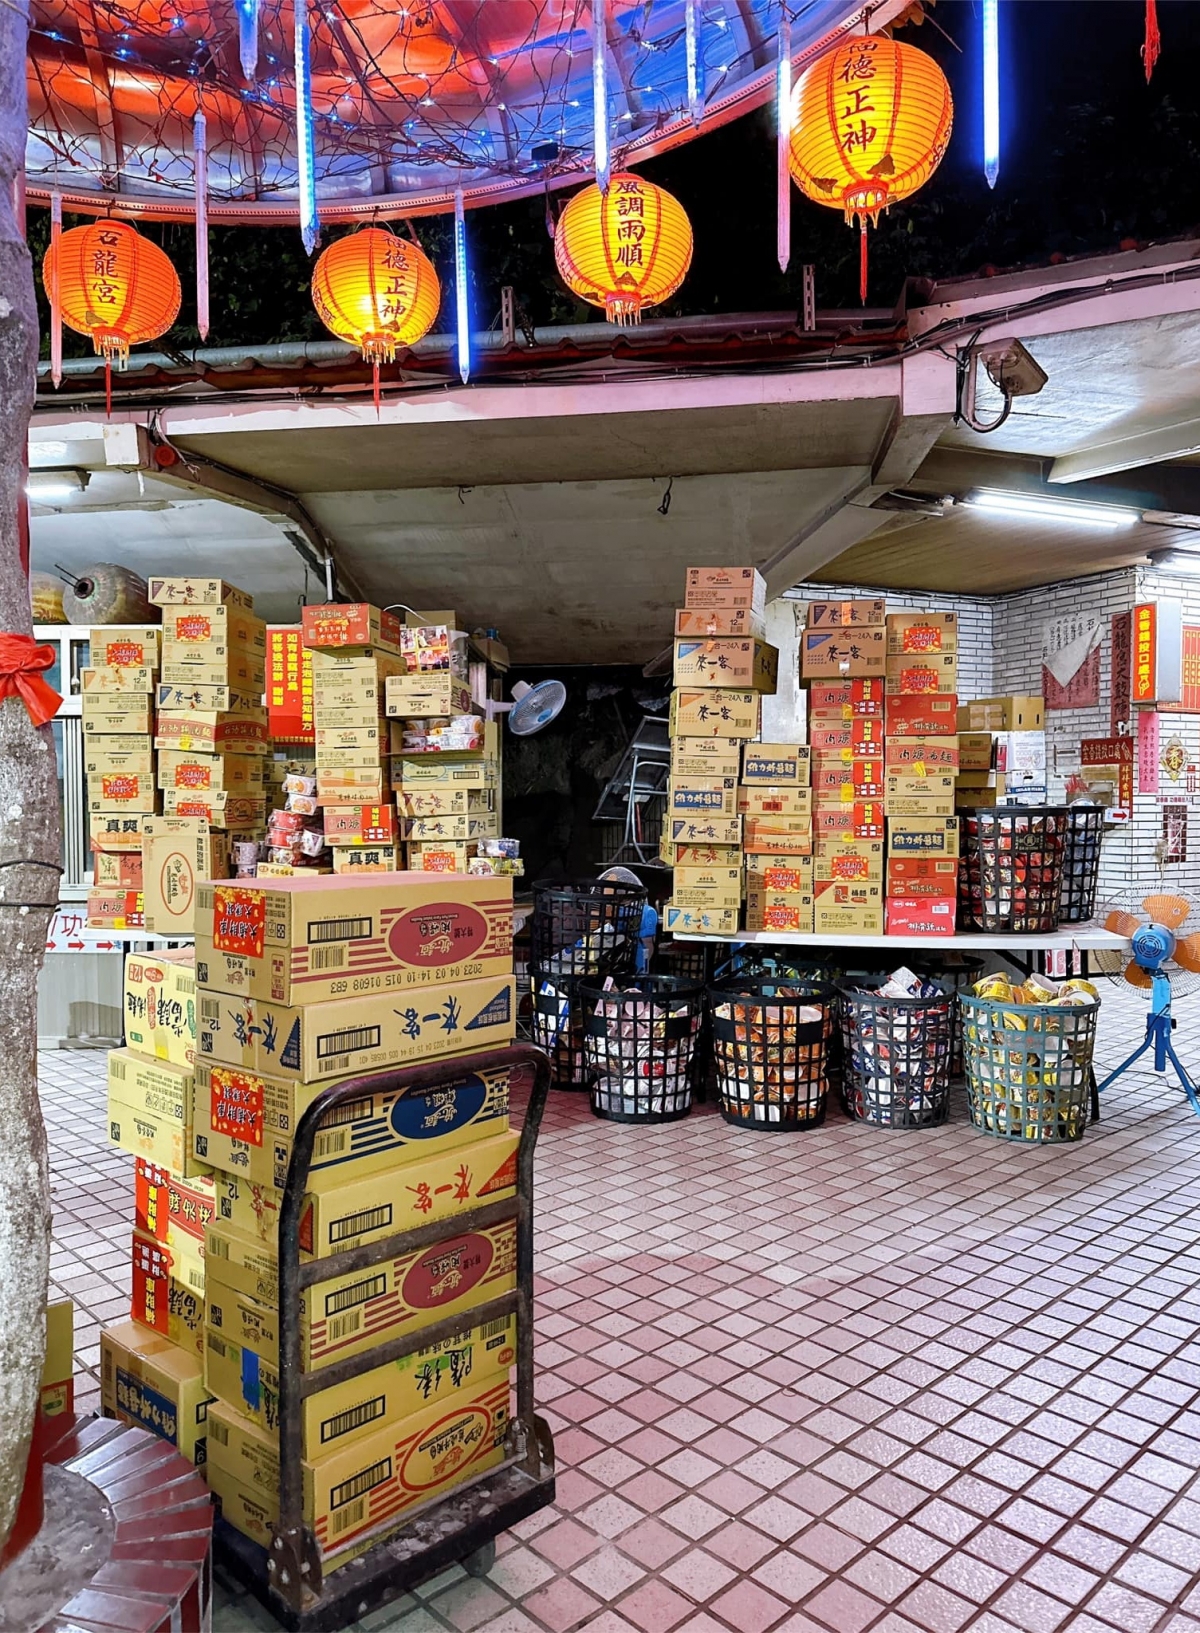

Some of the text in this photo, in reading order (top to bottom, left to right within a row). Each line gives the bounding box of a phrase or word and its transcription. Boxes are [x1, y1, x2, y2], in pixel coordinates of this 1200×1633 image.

[614, 181, 646, 268] 風調雨順
[91, 229, 123, 305] 石龍宮
[711, 642, 740, 650] 合一24入
[696, 653, 732, 672] 來一客
[301, 635, 313, 731] 帶走泡麵請告知廟方
[1114, 616, 1131, 736] 石龍宮大鼓陣
[697, 704, 735, 722] 來一客
[105, 818, 138, 834] 真爽
[349, 852, 380, 865] 真爽
[453, 926, 474, 938] 特大號
[385, 974, 401, 986] 015
[406, 970, 431, 983] 14:10
[435, 963, 483, 979] 2023.04.03
[353, 977, 381, 991] 01608
[209, 1019, 221, 1031] 12
[393, 994, 462, 1041] 來一客
[228, 1181, 240, 1200] 12
[405, 1163, 476, 1214] 來一客
[147, 1185, 158, 1233] 補財庫
[168, 1189, 213, 1231] 麻油雞
[145, 1277, 156, 1325] 補財庫
[414, 1346, 473, 1399] 隨緣
